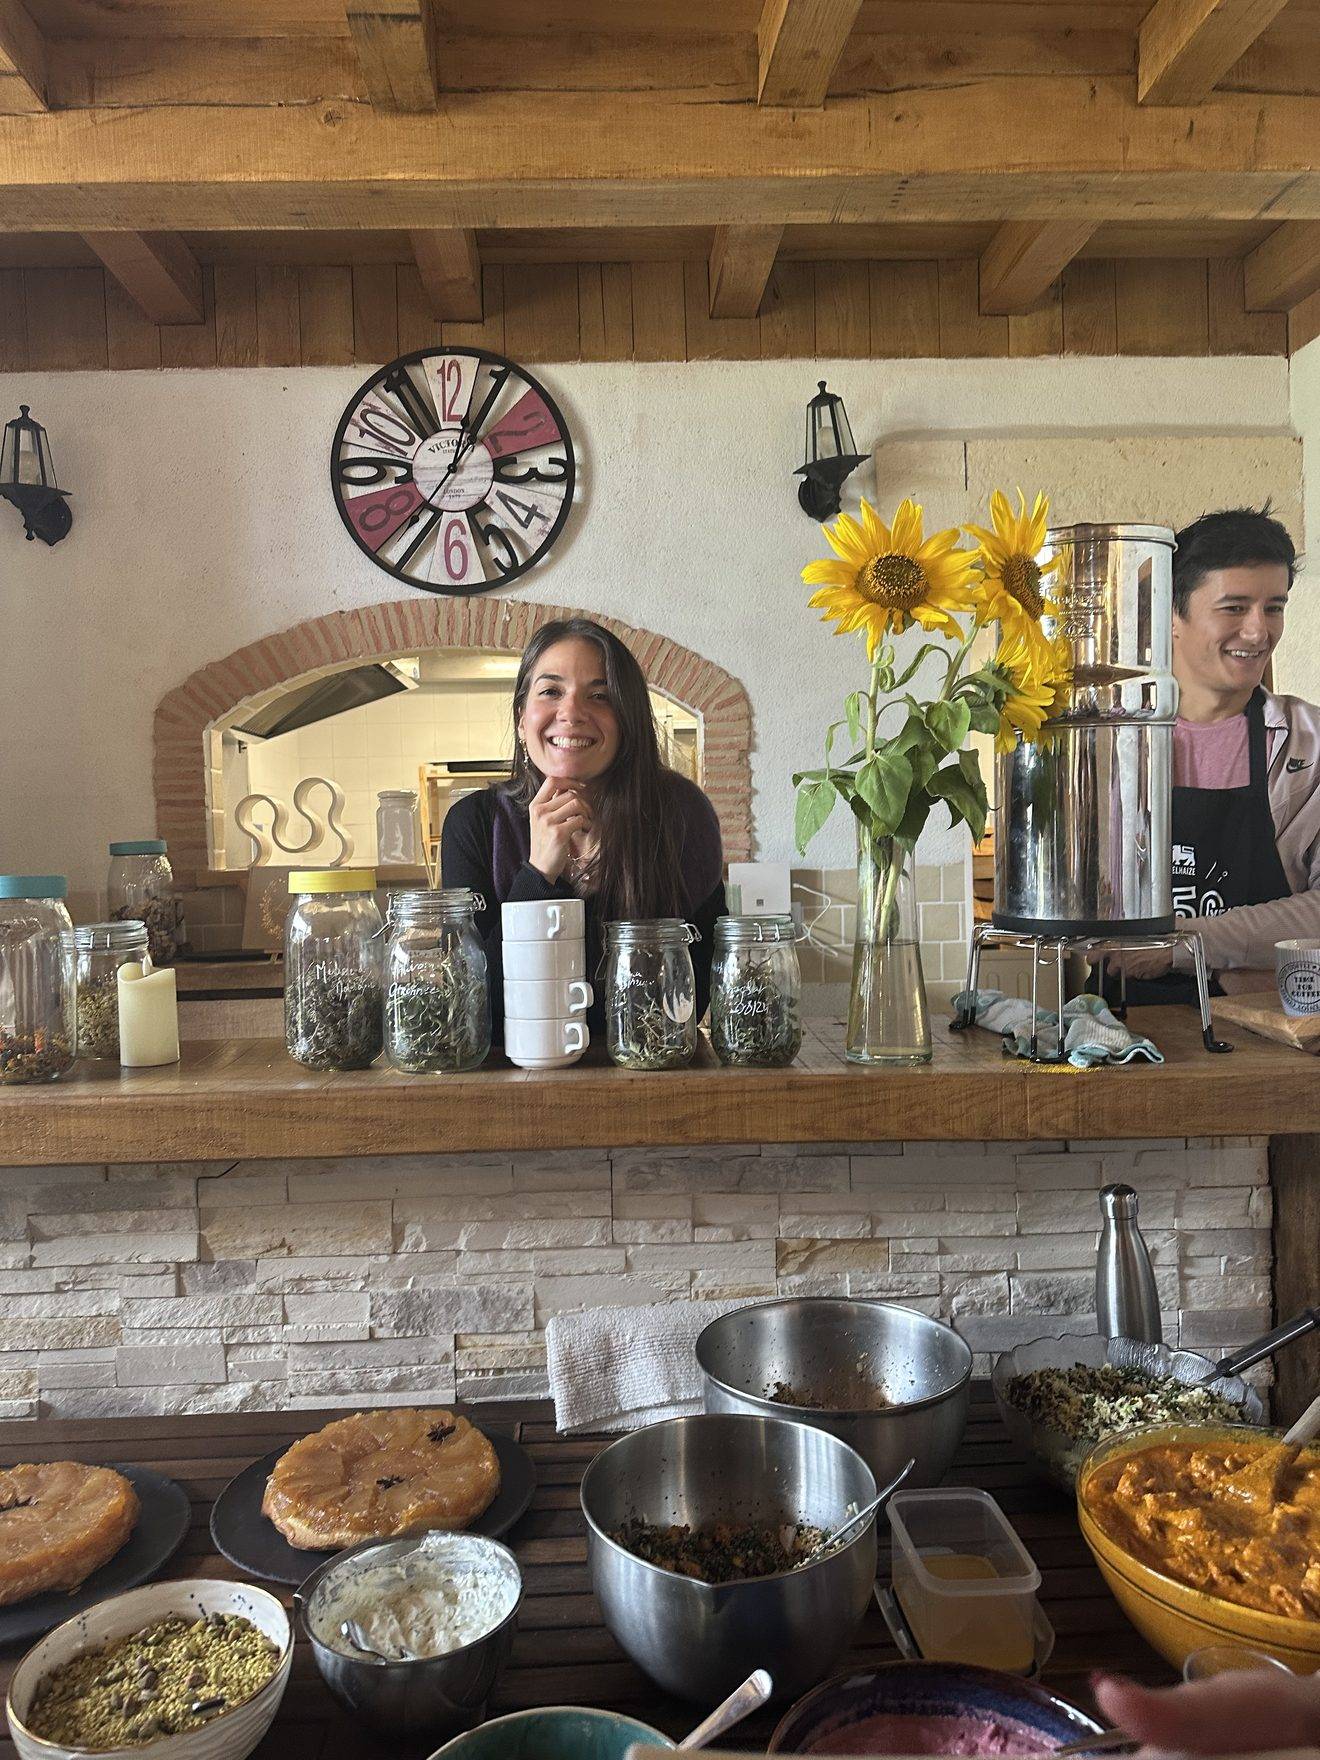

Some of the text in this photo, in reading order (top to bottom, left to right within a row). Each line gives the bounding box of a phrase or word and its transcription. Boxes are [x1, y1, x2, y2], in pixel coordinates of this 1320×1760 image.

[437, 359, 463, 422] 12
[489, 366, 513, 436] 1
[358, 408, 417, 457] 10
[490, 411, 547, 452] 2
[338, 456, 413, 485] 9
[494, 456, 568, 484] 3
[358, 489, 415, 531] 8
[495, 490, 550, 530] 4
[395, 502, 443, 572] 7
[443, 518, 469, 581] 6
[466, 502, 519, 577] 5
[1172, 866, 1196, 876] ELHAIZE
